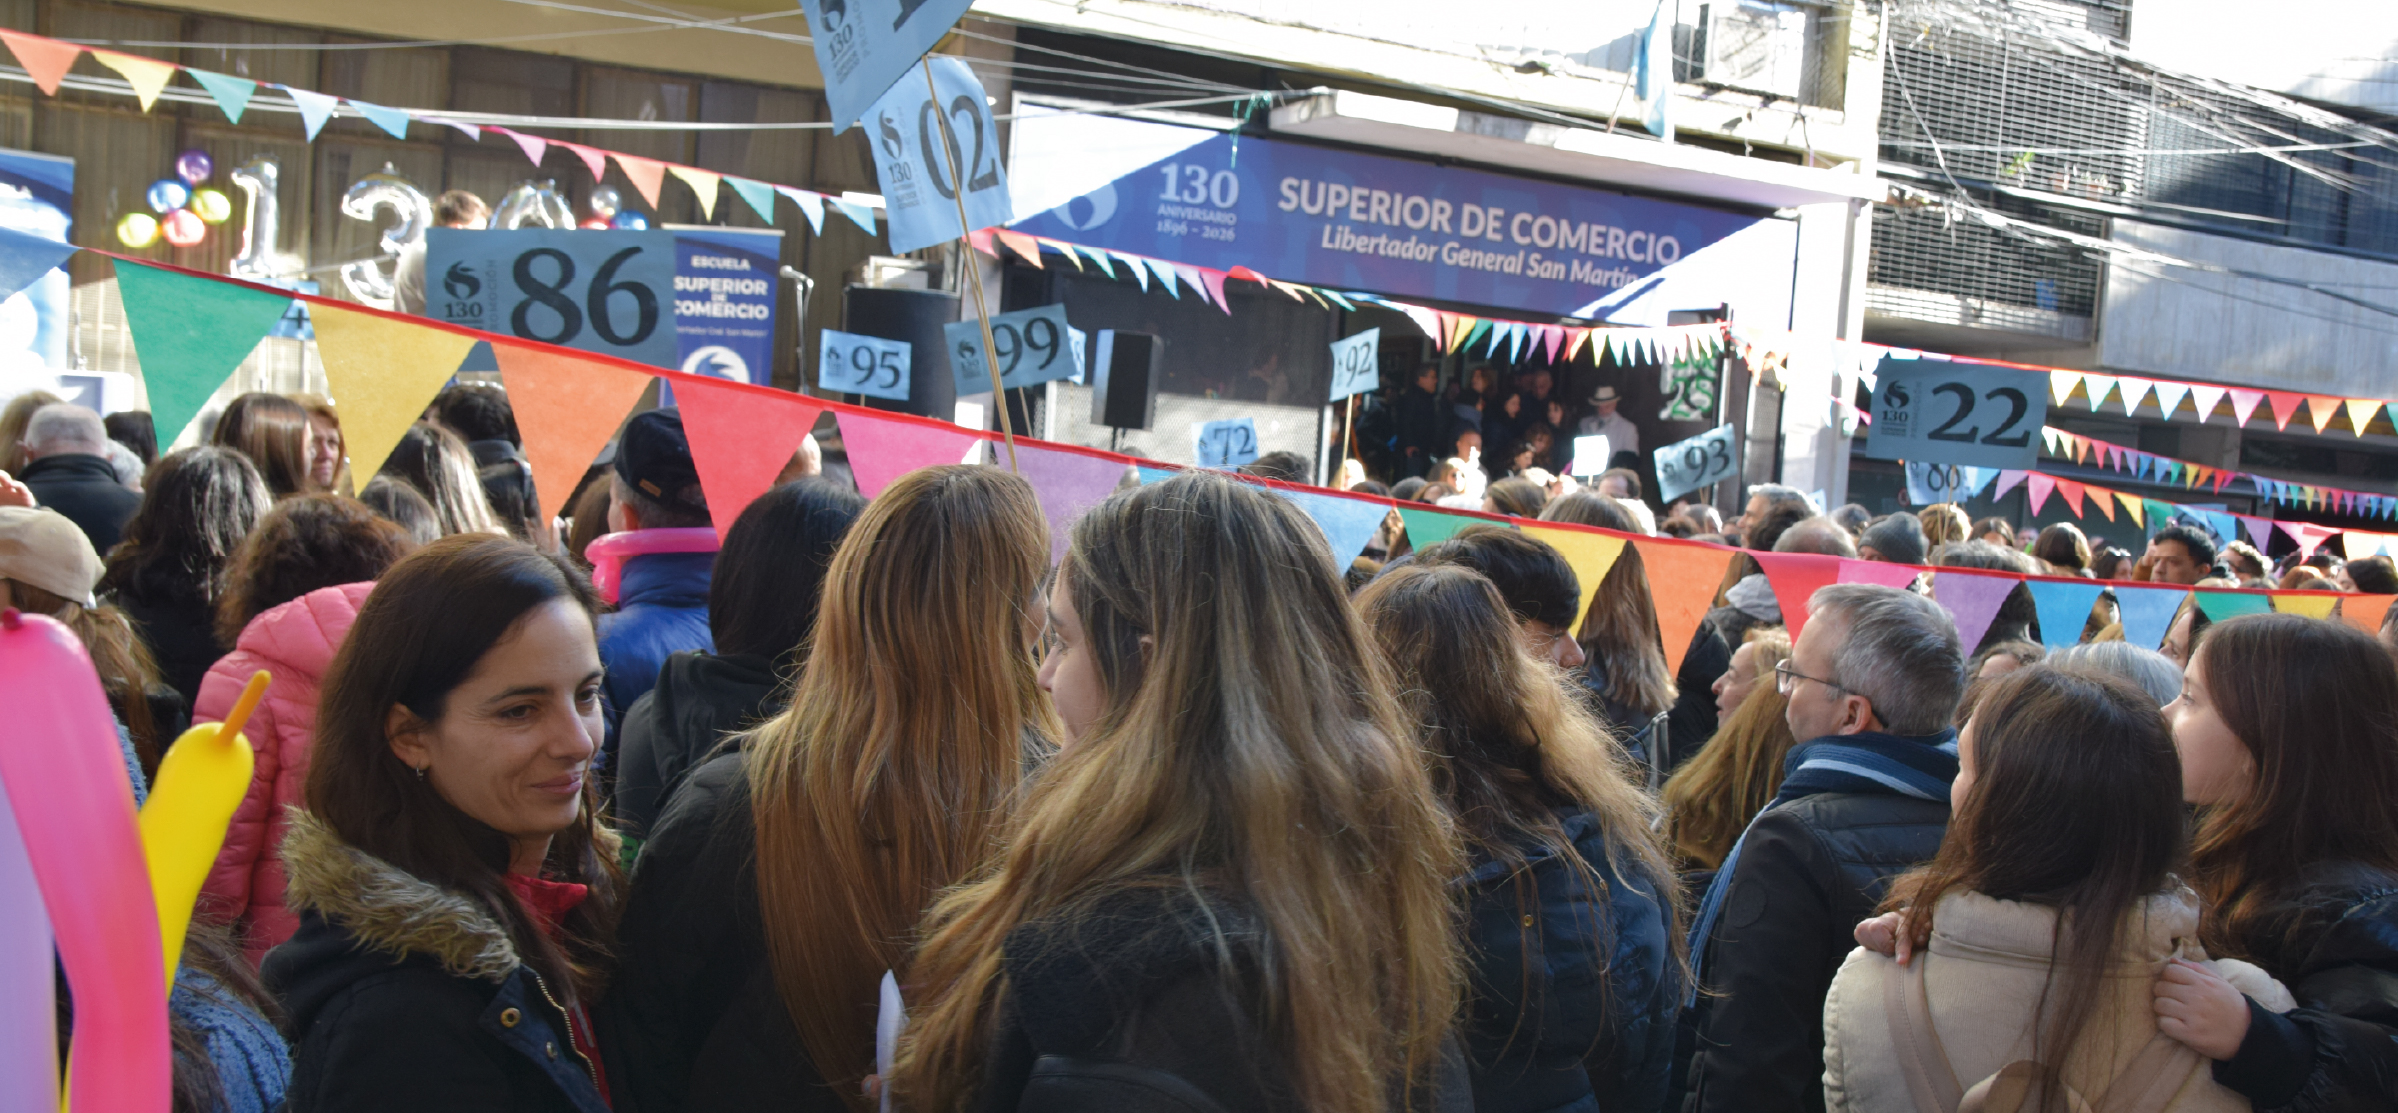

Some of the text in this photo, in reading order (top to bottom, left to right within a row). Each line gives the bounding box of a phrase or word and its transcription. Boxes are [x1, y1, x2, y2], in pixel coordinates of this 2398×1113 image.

[827, 24, 854, 62] 130
[918, 95, 1000, 200] 02
[888, 161, 913, 184] 130
[1158, 162, 1240, 209] 130
[1156, 219, 1188, 238] 1896
[1202, 224, 1236, 243] 2026
[1157, 203, 1238, 226] ANIVERSARIO
[1277, 176, 1681, 266] SUPERIOR DE COMERCIO
[690, 255, 752, 271] ESCUELA
[1321, 223, 1439, 263] Libertador
[1440, 241, 1526, 275] General
[1525, 251, 1566, 281] San
[509, 245, 660, 347] 86
[673, 275, 769, 296] SUPERIOR
[444, 301, 484, 319] 130
[851, 345, 902, 389] 95
[990, 316, 1060, 377] 99
[1346, 341, 1372, 388] 92
[1881, 409, 1909, 423] 130
[1927, 381, 2031, 448] 22
[1213, 425, 1255, 465] 72
[1684, 438, 1730, 483] 93
